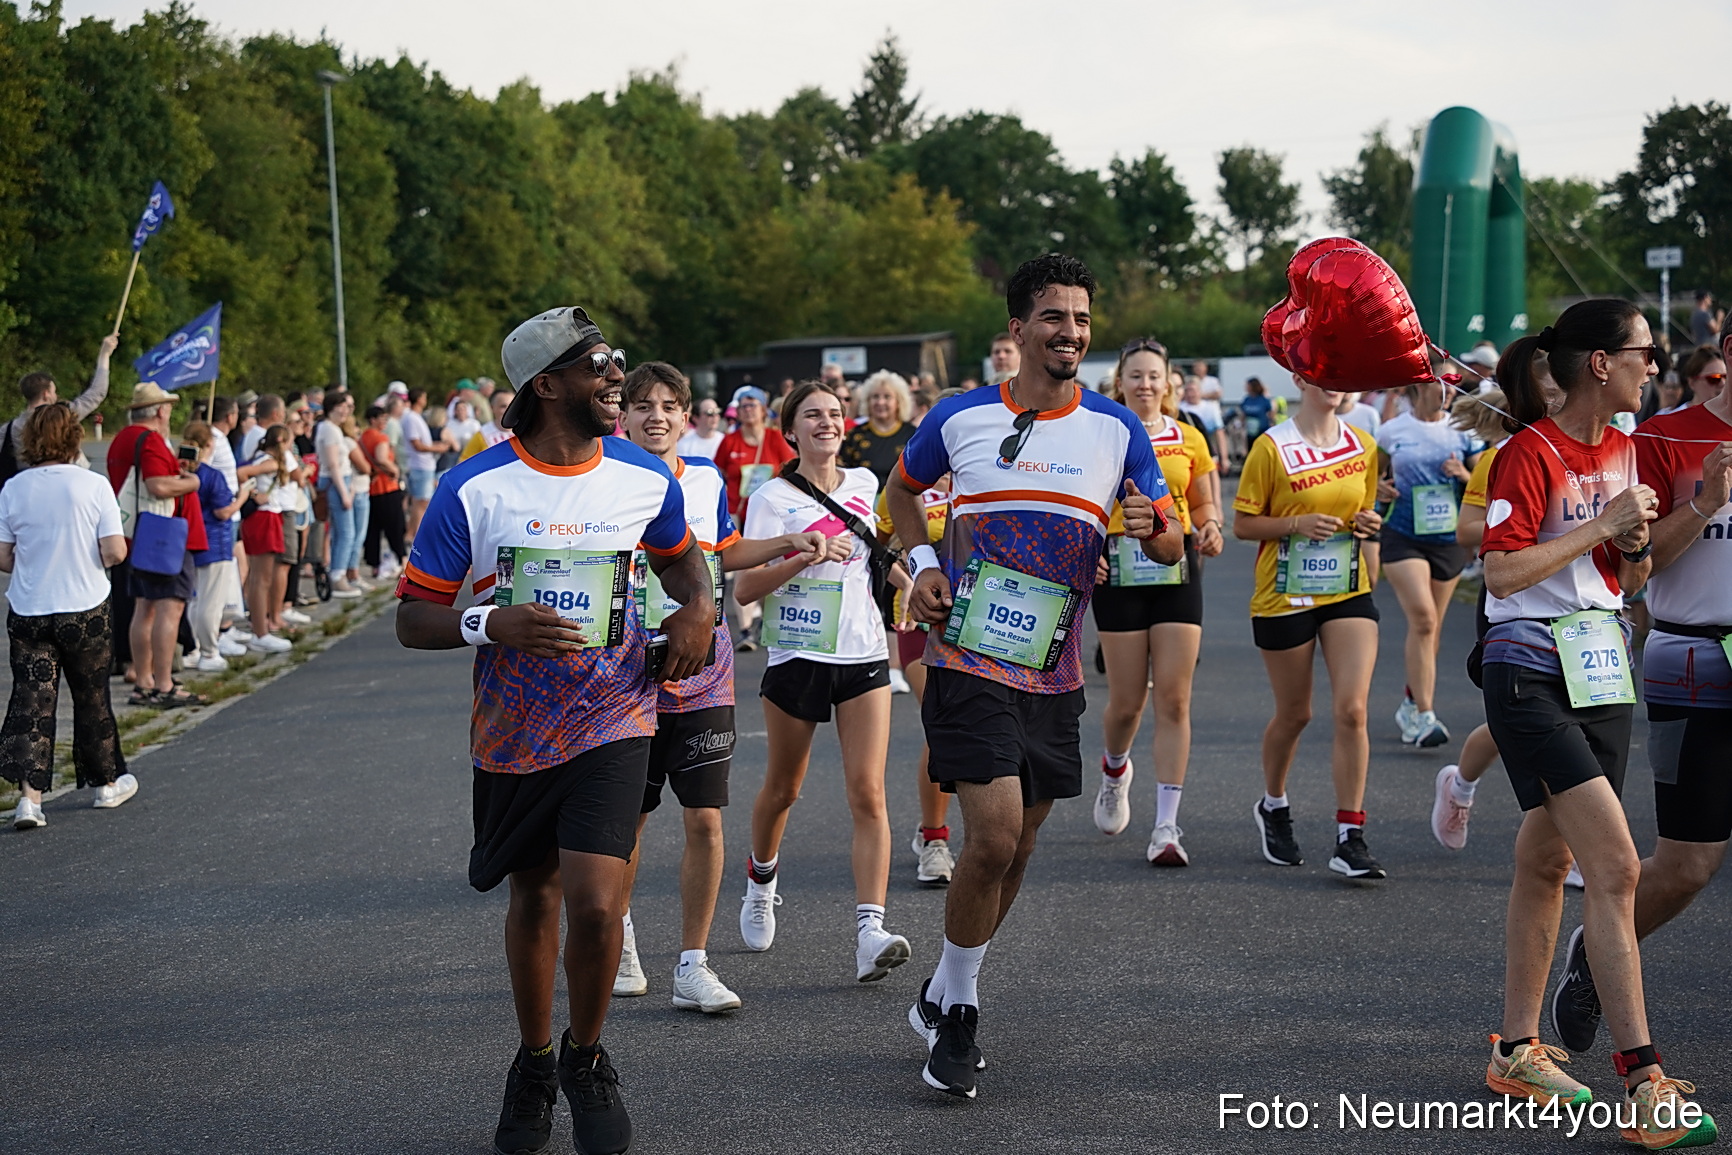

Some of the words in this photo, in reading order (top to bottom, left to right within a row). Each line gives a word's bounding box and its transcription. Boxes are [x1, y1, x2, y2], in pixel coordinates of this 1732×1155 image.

[1017, 461, 1083, 476] PEKUFolien
[1290, 472, 1331, 493] MAX
[927, 510, 947, 520] AX
[1426, 504, 1450, 515] 332
[549, 521, 620, 536] PEKUFolien
[1302, 559, 1338, 571] 1690
[533, 589, 590, 611] 1984
[779, 606, 821, 624] 1949
[987, 602, 1037, 632] 1993
[610, 611, 620, 640] HILTL
[779, 624, 799, 633] Selma
[800, 627, 821, 635] Böhler
[984, 624, 1007, 638] Parsa
[1007, 631, 1033, 645] Rezaei
[1046, 642, 1060, 666] HILTL
[1580, 649, 1619, 669] 2176
[1587, 674, 1611, 683] Regina
